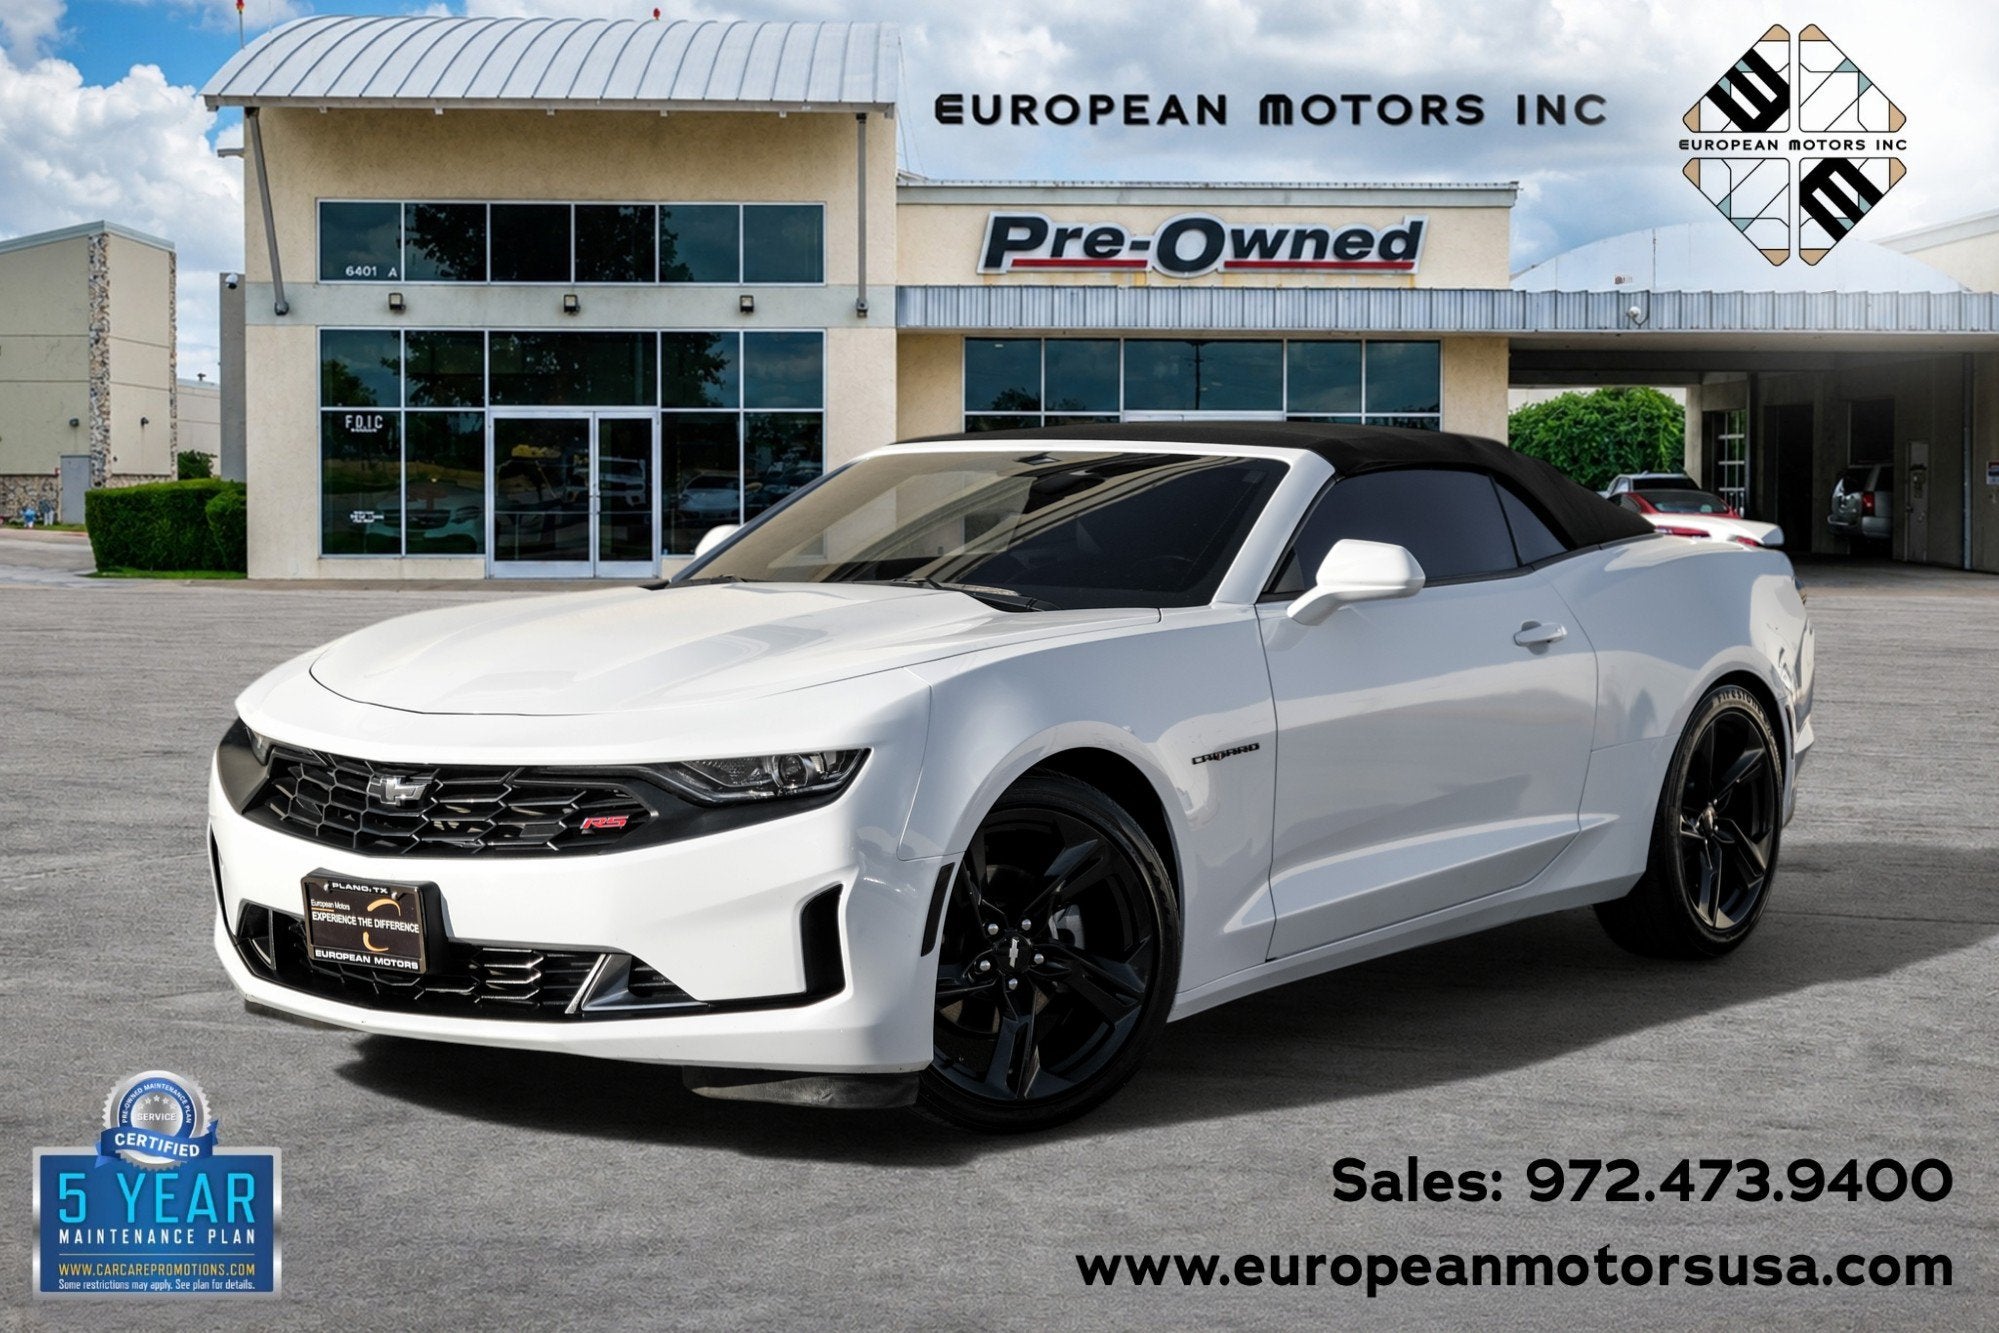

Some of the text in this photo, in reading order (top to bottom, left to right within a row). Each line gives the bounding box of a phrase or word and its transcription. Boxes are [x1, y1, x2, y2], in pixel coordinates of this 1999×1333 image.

[984, 215, 1424, 273] Pre-Owned
[345, 265, 398, 278] 6401 A
[580, 815, 629, 830] RS
[373, 886, 388, 894] TX
[310, 899, 351, 911] European Motors
[312, 911, 420, 934] EXPERIENCE THE DIFFERENCE
[315, 949, 419, 970] EUROPEAN MOTORS
